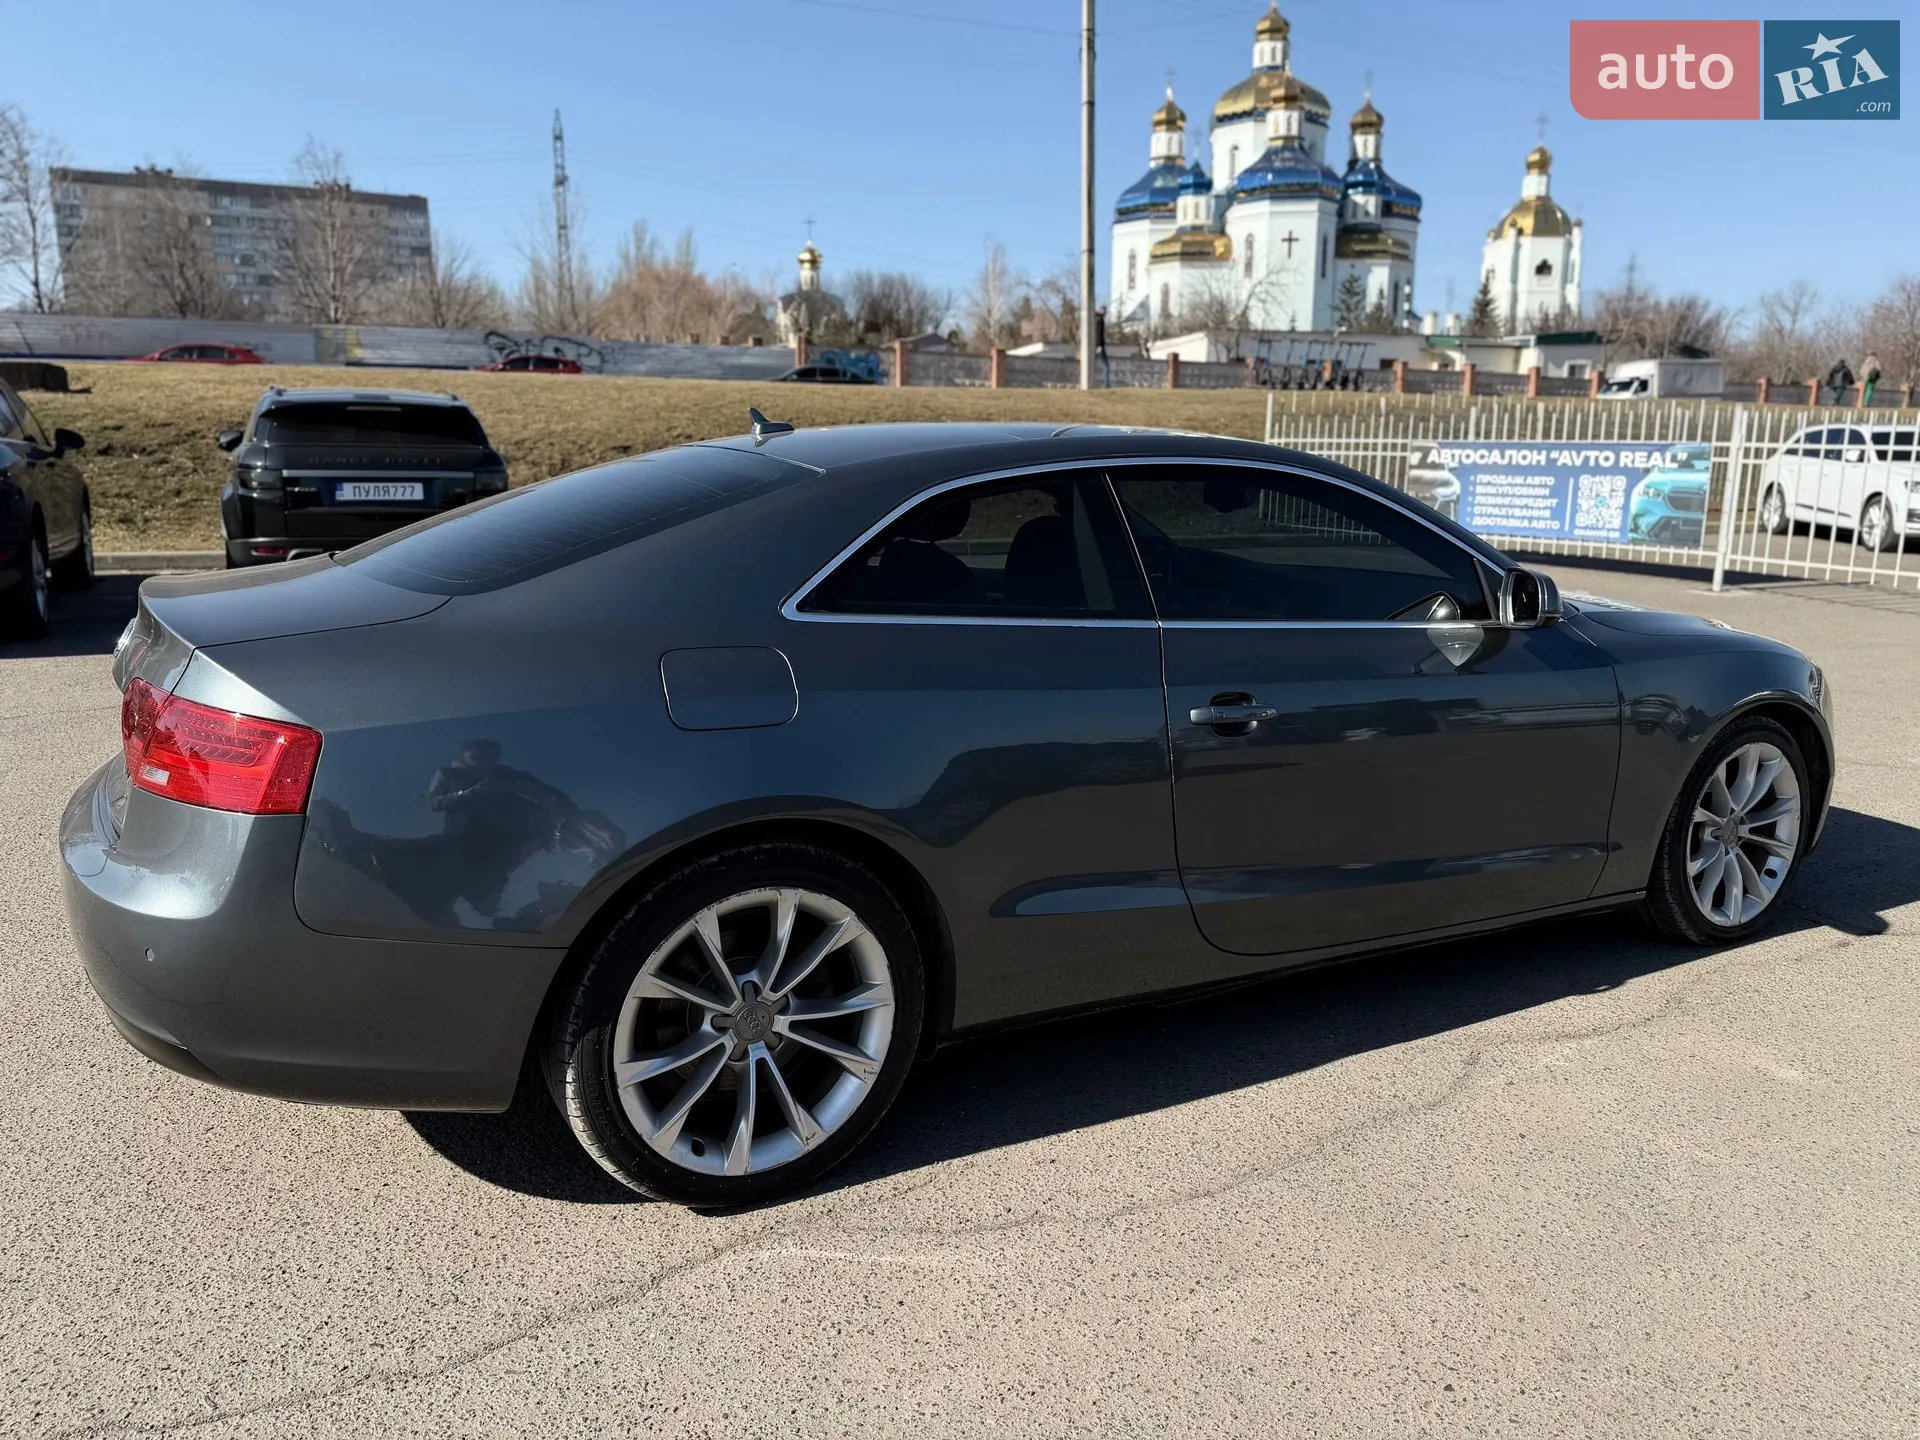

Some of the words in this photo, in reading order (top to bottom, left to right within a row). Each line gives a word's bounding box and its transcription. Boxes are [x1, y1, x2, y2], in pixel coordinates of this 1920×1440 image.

[1427, 449, 1547, 466] АВТОСАЛОН
[1476, 474, 1524, 485] ПРОДАЖ
[1525, 475, 1555, 487] АВТО
[352, 485, 416, 498] ПУЛЯ777
[1529, 518, 1560, 530] АВТО
